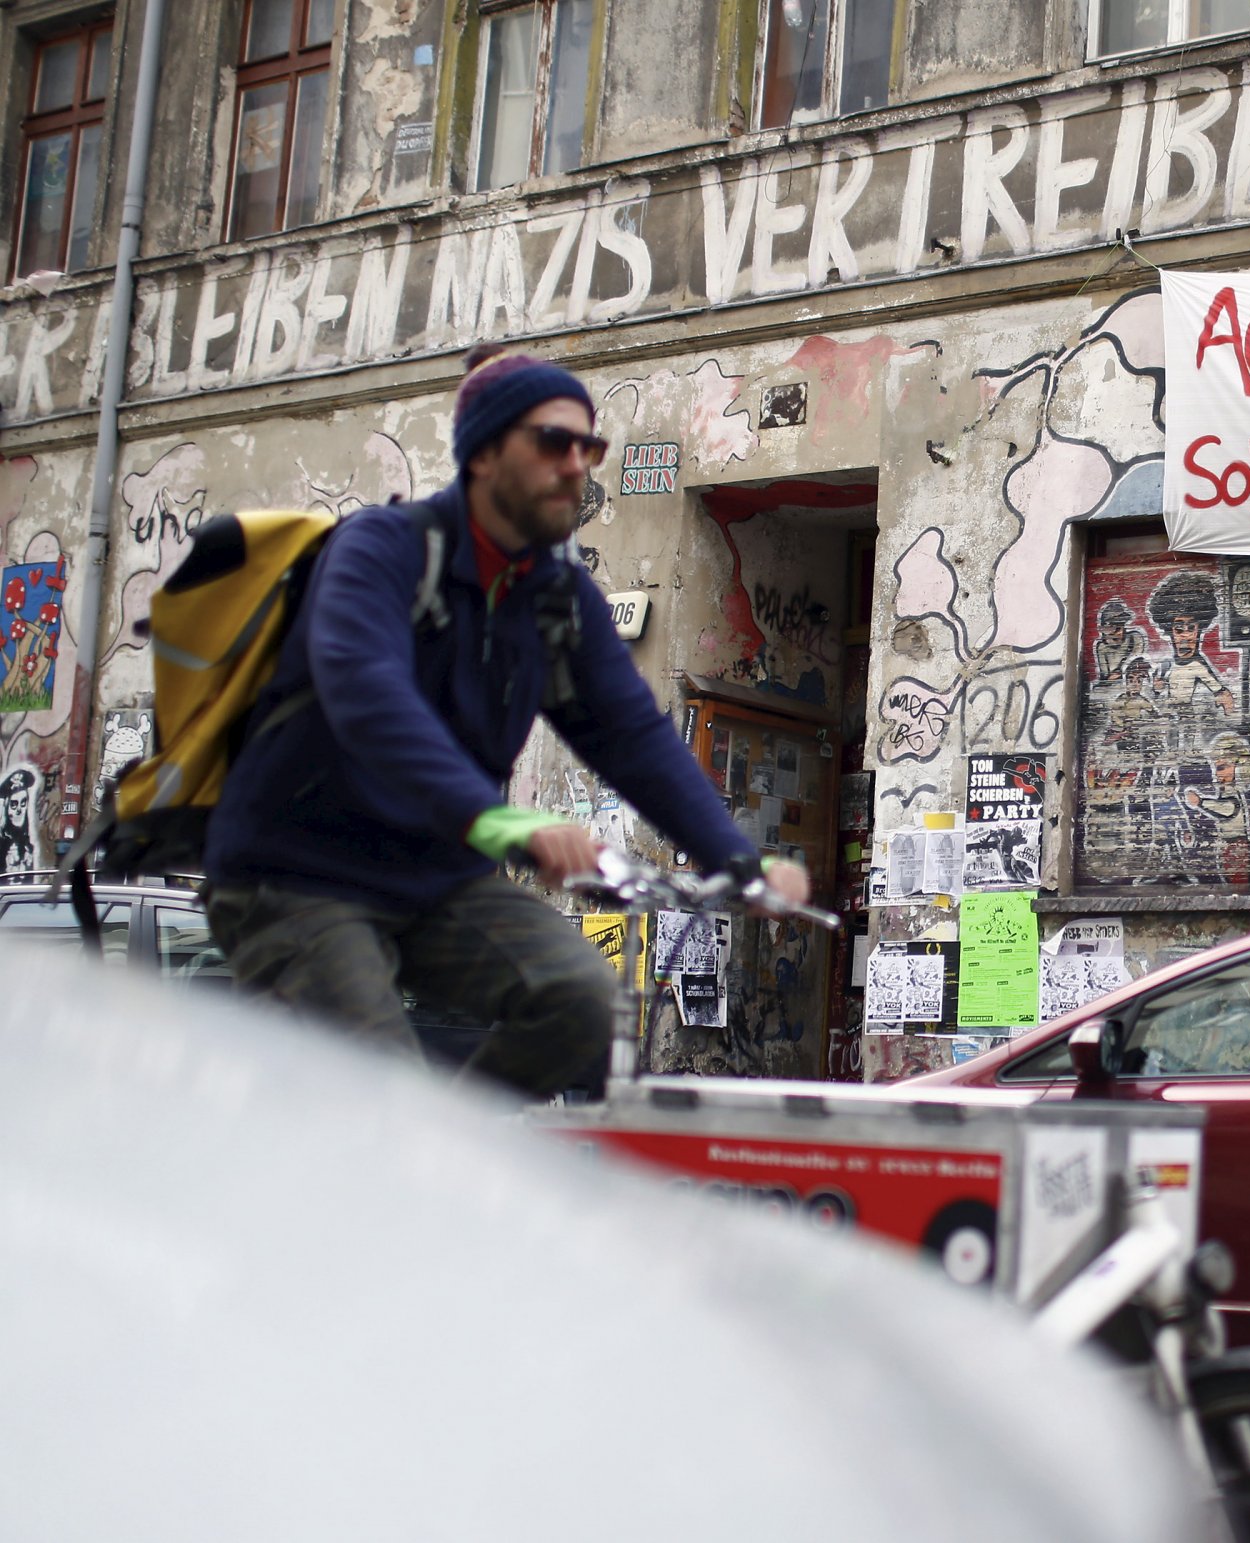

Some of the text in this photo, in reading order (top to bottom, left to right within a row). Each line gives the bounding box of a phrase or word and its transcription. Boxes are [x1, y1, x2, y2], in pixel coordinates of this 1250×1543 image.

[79, 226, 412, 408] BLEIBEN
[425, 178, 653, 349] NAZIS
[623, 443, 679, 468] LIEB
[621, 467, 677, 494] SEIN
[967, 674, 1064, 750] 206
[971, 759, 994, 772] TON
[970, 773, 1006, 787] STEINE
[969, 787, 1024, 802] SCHERBEN
[982, 803, 1043, 820] PARTY
